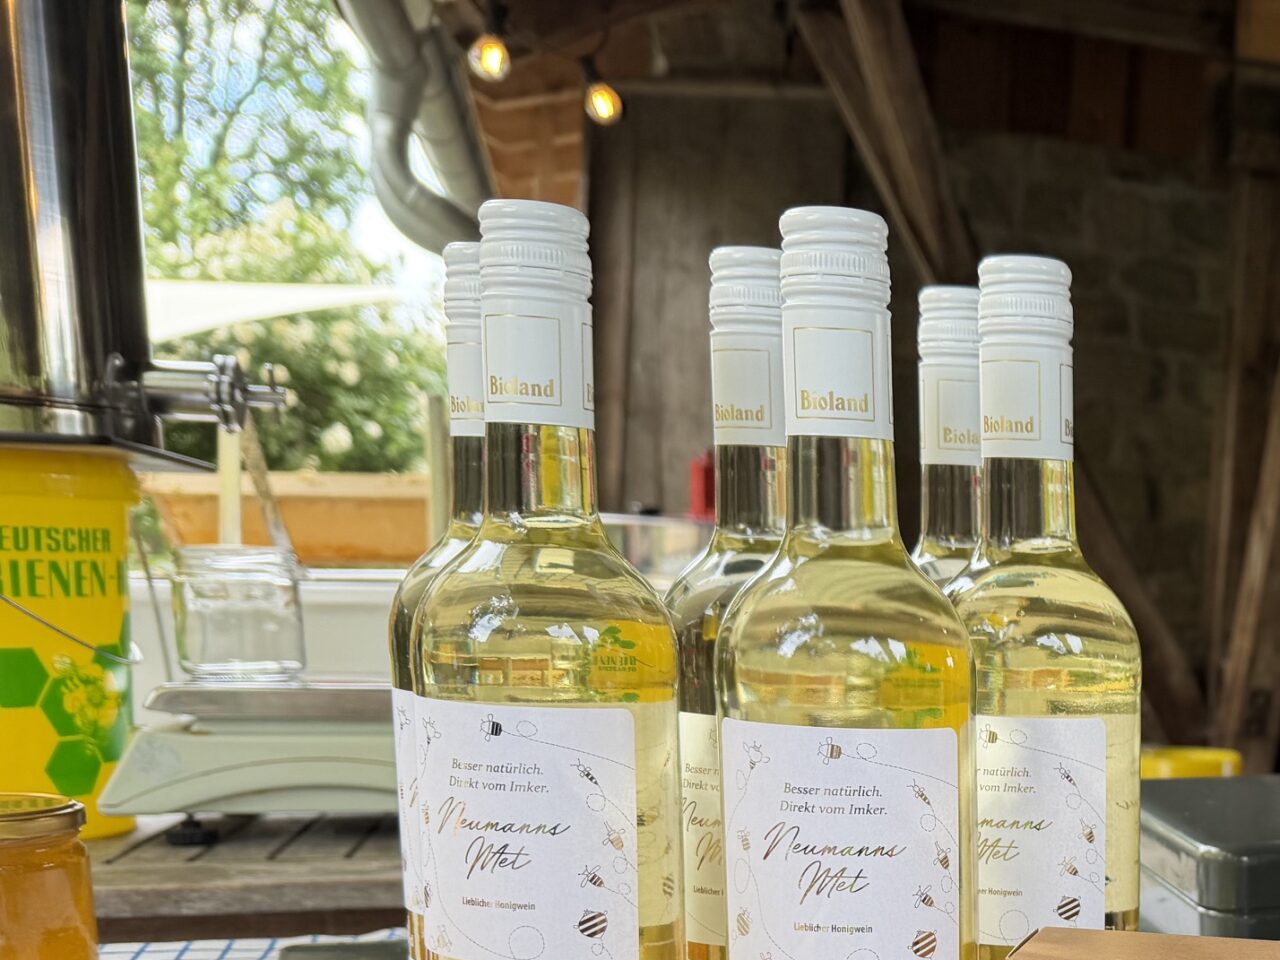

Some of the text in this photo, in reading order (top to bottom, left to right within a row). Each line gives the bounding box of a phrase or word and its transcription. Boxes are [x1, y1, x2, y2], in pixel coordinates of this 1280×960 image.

[490, 375, 555, 397] Bioland
[800, 390, 868, 412] Bioland
[715, 404, 764, 421] Bioland
[983, 415, 1034, 433] Bioland
[943, 427, 980, 445] Biola
[452, 758, 544, 775] Besser natürlich.
[685, 763, 713, 775] Besser
[983, 766, 1032, 778] natürlich.
[449, 776, 550, 793] Direkt vom Imker.
[682, 778, 708, 791] Direkt
[784, 782, 883, 797] Besser natürlich.
[979, 783, 1037, 794] vom Imker.
[438, 796, 571, 835] Neumanns
[780, 801, 888, 815] Direkt vom Imker.
[977, 818, 1053, 831] manns
[763, 822, 907, 861] Neumanns
[465, 836, 532, 880] Met
[798, 861, 870, 905] Met
[988, 888, 1024, 898] Honigwein
[495, 900, 536, 911] Honigwein
[831, 924, 873, 935] Honigwein
